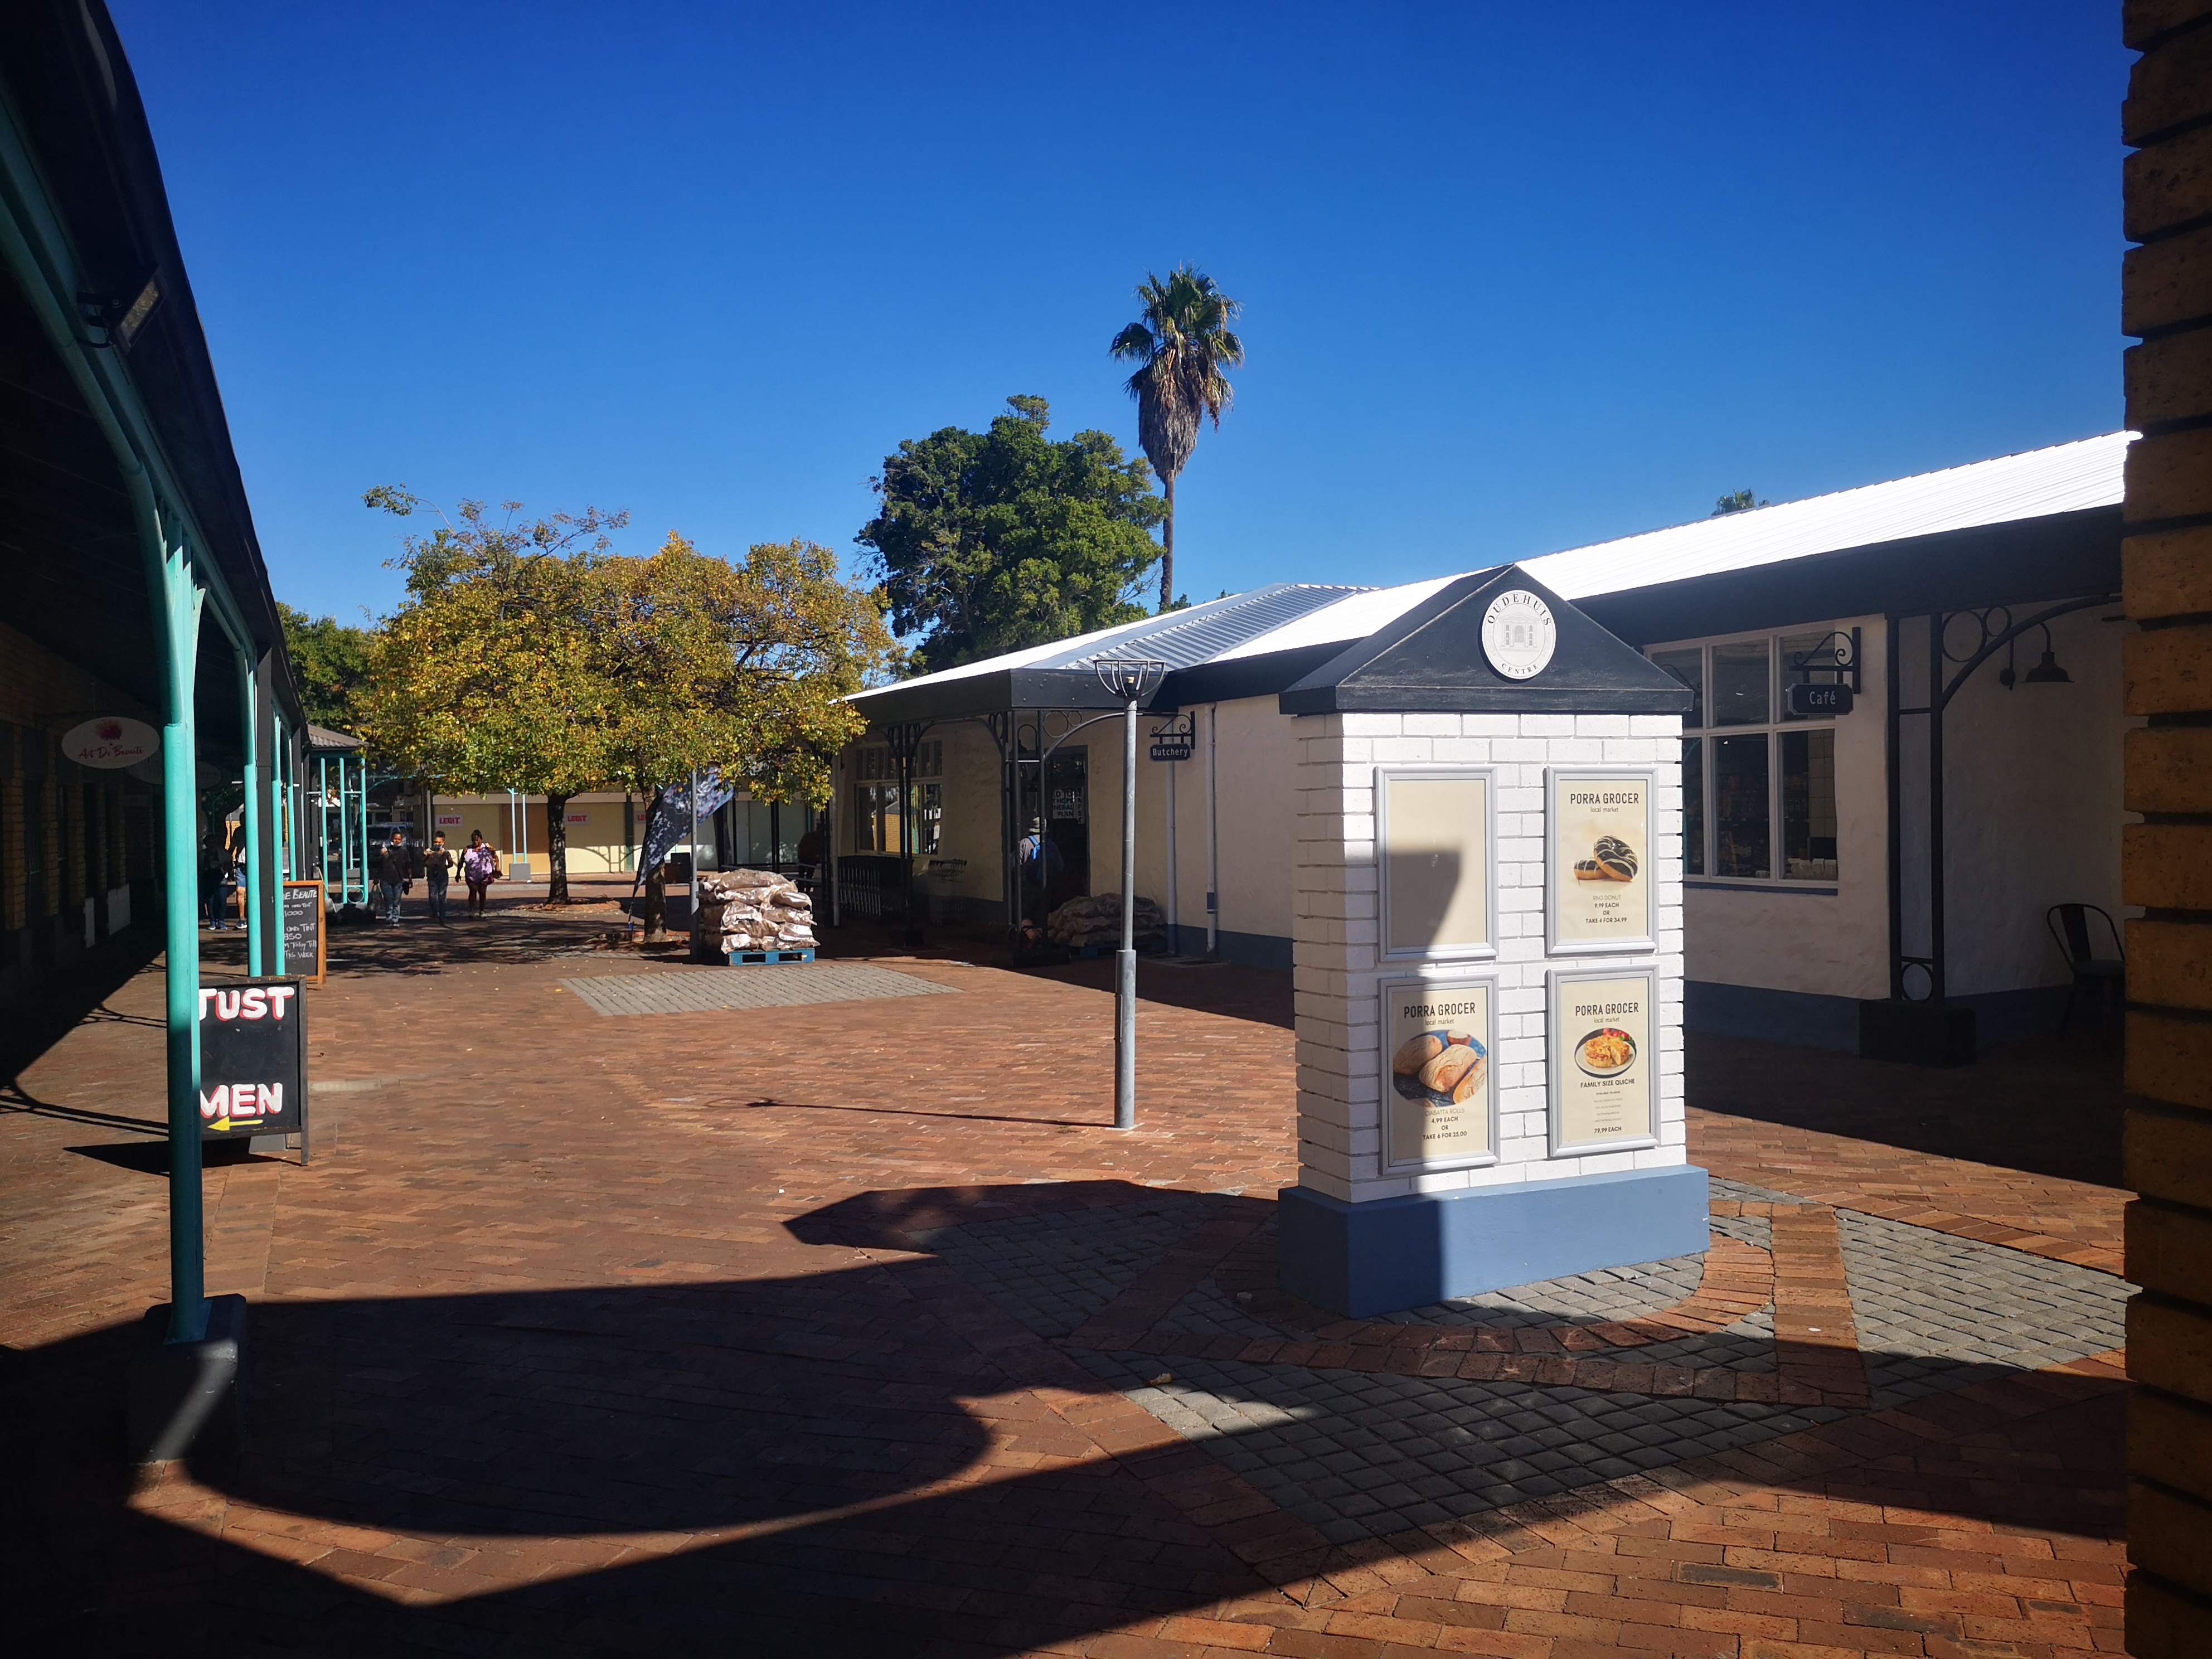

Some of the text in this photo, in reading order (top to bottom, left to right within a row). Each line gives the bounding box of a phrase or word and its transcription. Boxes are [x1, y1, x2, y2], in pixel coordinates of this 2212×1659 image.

[1487, 593, 1551, 626] OUDEHUIS
[1501, 663, 1538, 675] CENTRE
[1809, 691, 1836, 705] Café
[1152, 748, 1188, 757] Butchery
[1570, 793, 1639, 804] PORRA GROCER
[1404, 1002, 1476, 1018] PORRA GROCER
[1575, 1002, 1638, 1016] PORRA GROCER
[200, 1083, 283, 1118] MEN
